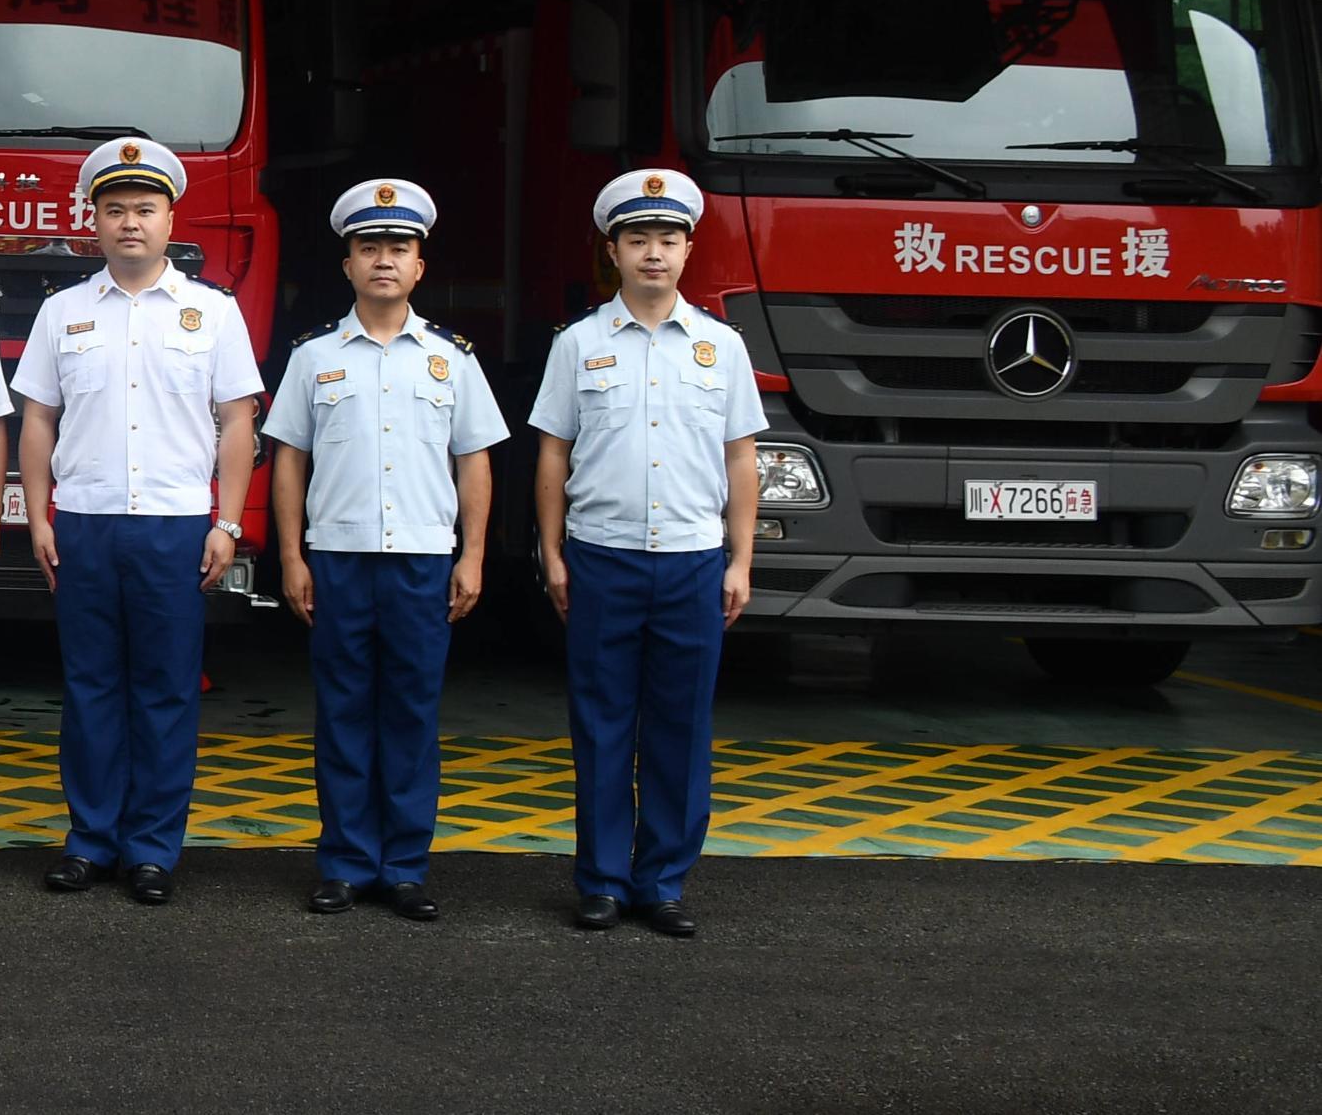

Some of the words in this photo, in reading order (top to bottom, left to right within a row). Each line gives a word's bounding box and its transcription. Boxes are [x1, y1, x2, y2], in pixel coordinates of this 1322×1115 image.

[893, 222, 946, 273] 救
[955, 245, 1112, 276] RESCUE
[1121, 227, 1171, 278] 援
